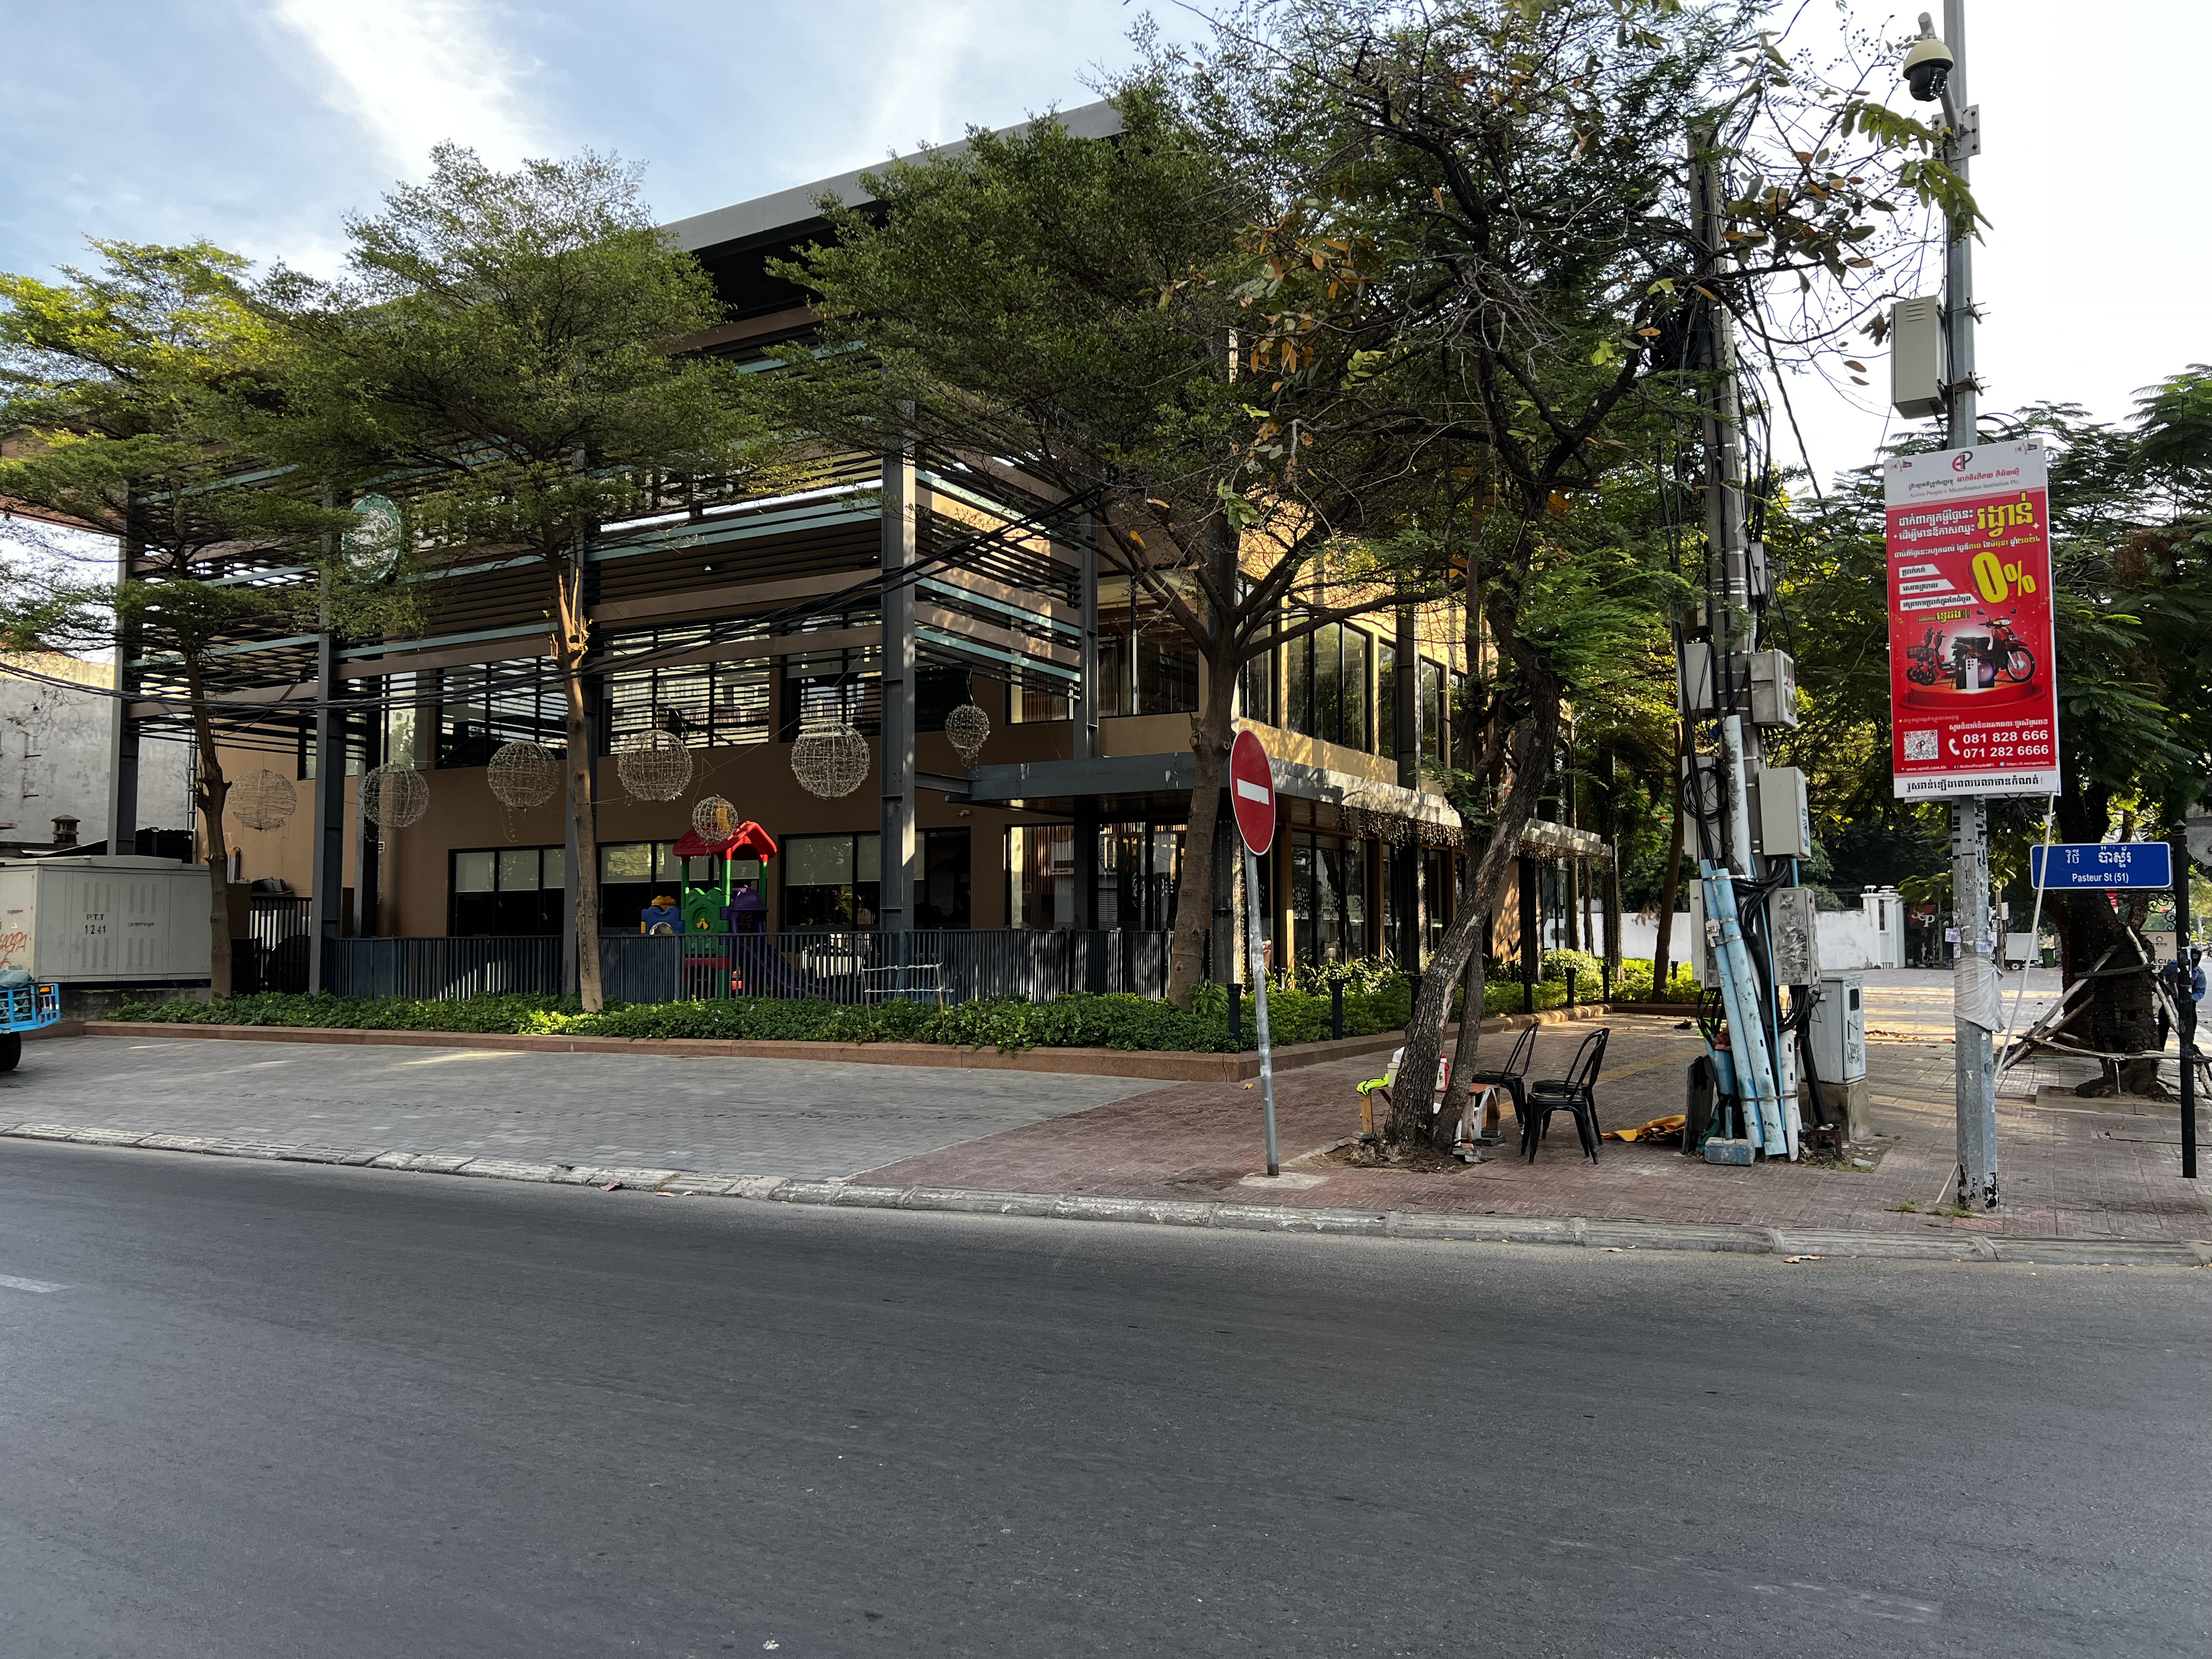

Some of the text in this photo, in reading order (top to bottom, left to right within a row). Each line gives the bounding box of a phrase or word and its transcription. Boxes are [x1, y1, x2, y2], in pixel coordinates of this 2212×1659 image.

[1949, 484, 1982, 493] Microfinance
[1976, 492, 2033, 538] រង្វាន់
[1970, 551, 2036, 603] 0%
[1963, 730, 2048, 744] 081 828 666
[1963, 745, 2049, 758] 071 282 6666
[2072, 873, 2129, 884] Pasteur St (51)
[85, 925, 106, 935] 1241
